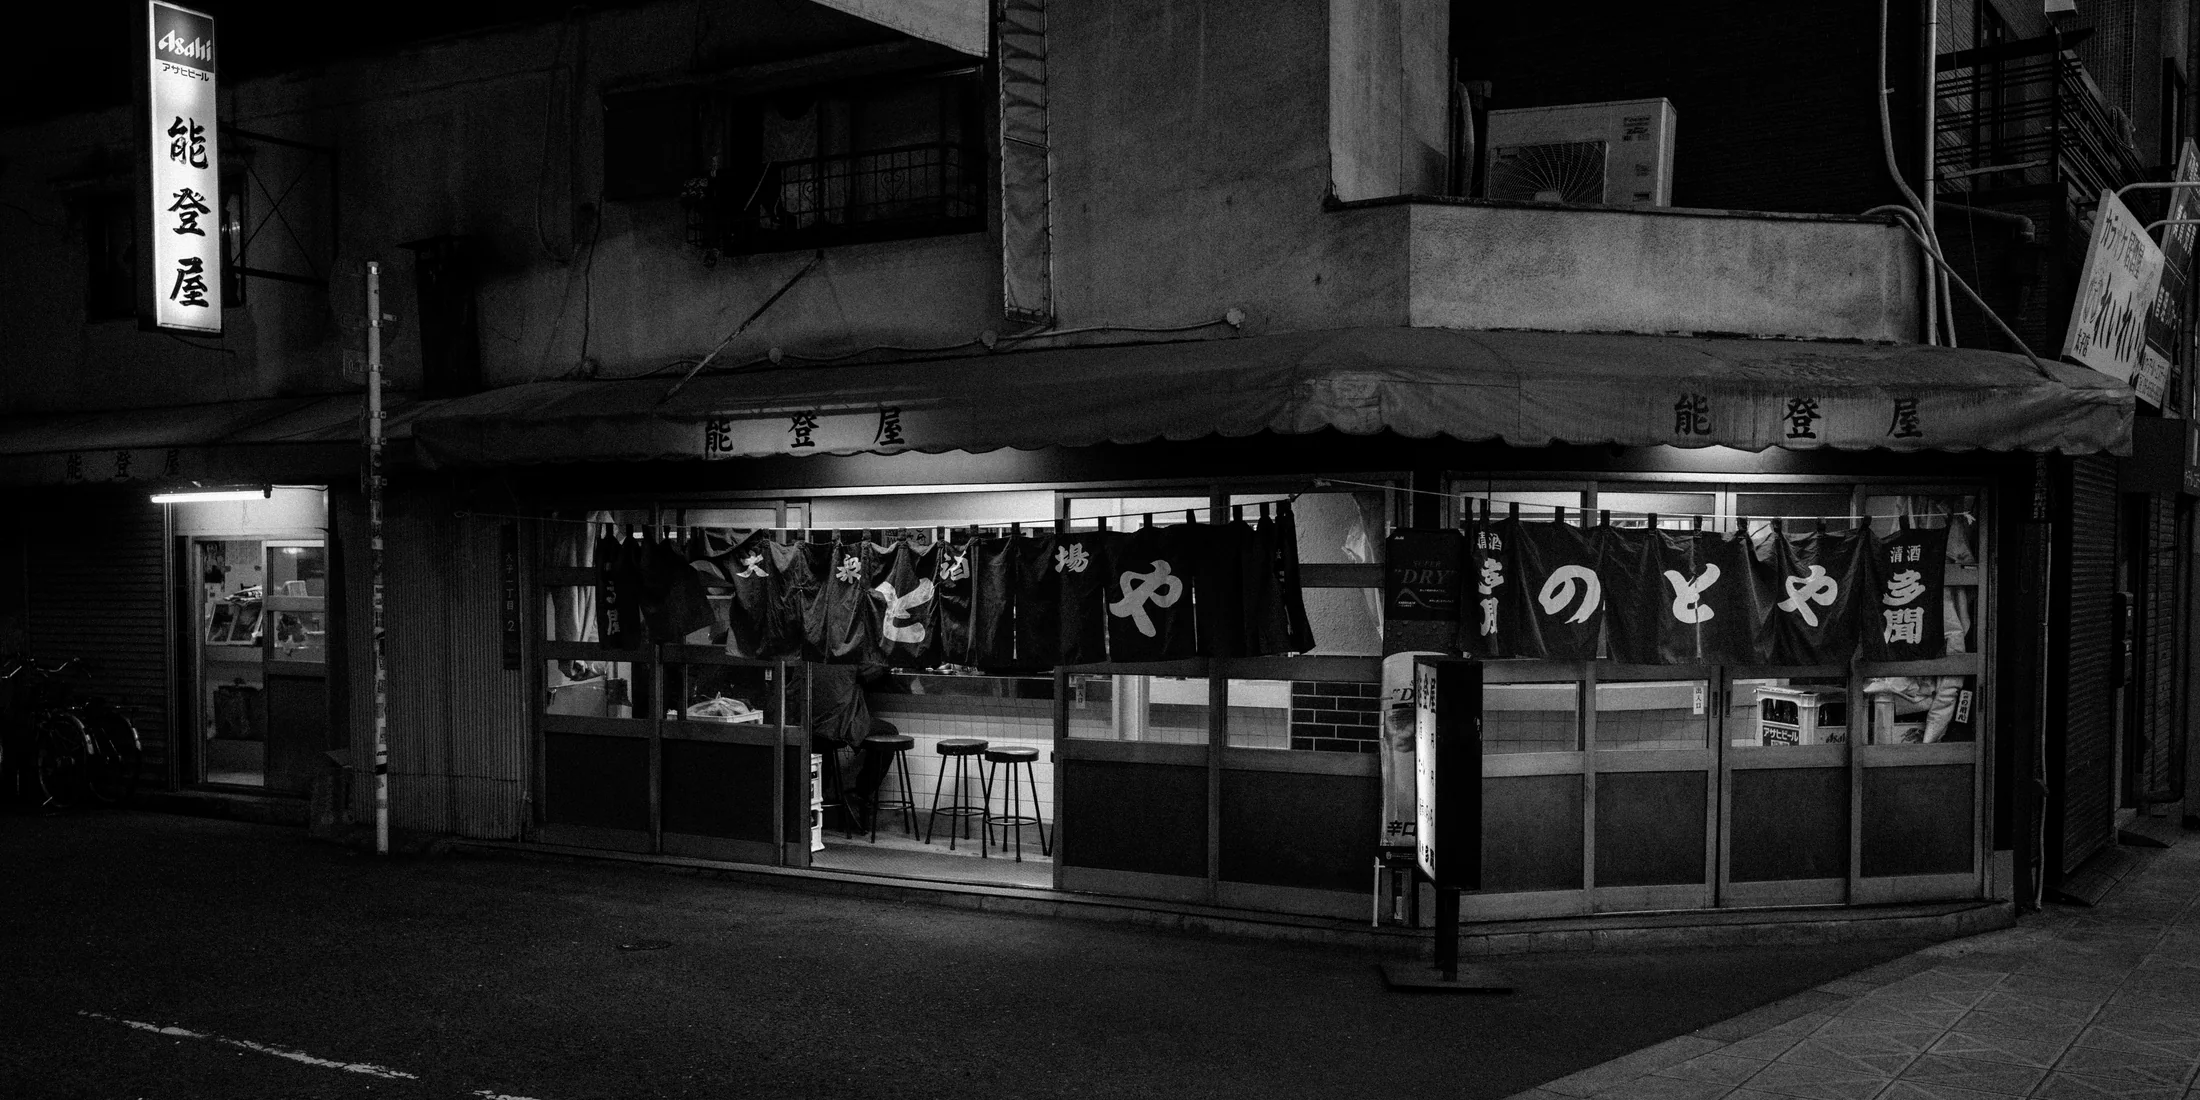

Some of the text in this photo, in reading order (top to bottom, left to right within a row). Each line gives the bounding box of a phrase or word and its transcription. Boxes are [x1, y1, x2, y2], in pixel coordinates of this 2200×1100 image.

[158, 29, 212, 62] Asahi
[162, 62, 210, 82] アサヒビール
[167, 115, 211, 308] 能登屋
[1674, 393, 1923, 439] 能登屋
[704, 405, 905, 460] 能登屋
[1890, 544, 1922, 564] 清酒
[1538, 563, 1838, 628] のとや
[1883, 568, 1927, 645] 多聞
[506, 619, 515, 632] 2
[1763, 727, 1799, 742] アサヒビール
[1825, 732, 1846, 744] Asa
[1387, 819, 1416, 837] 辛口
